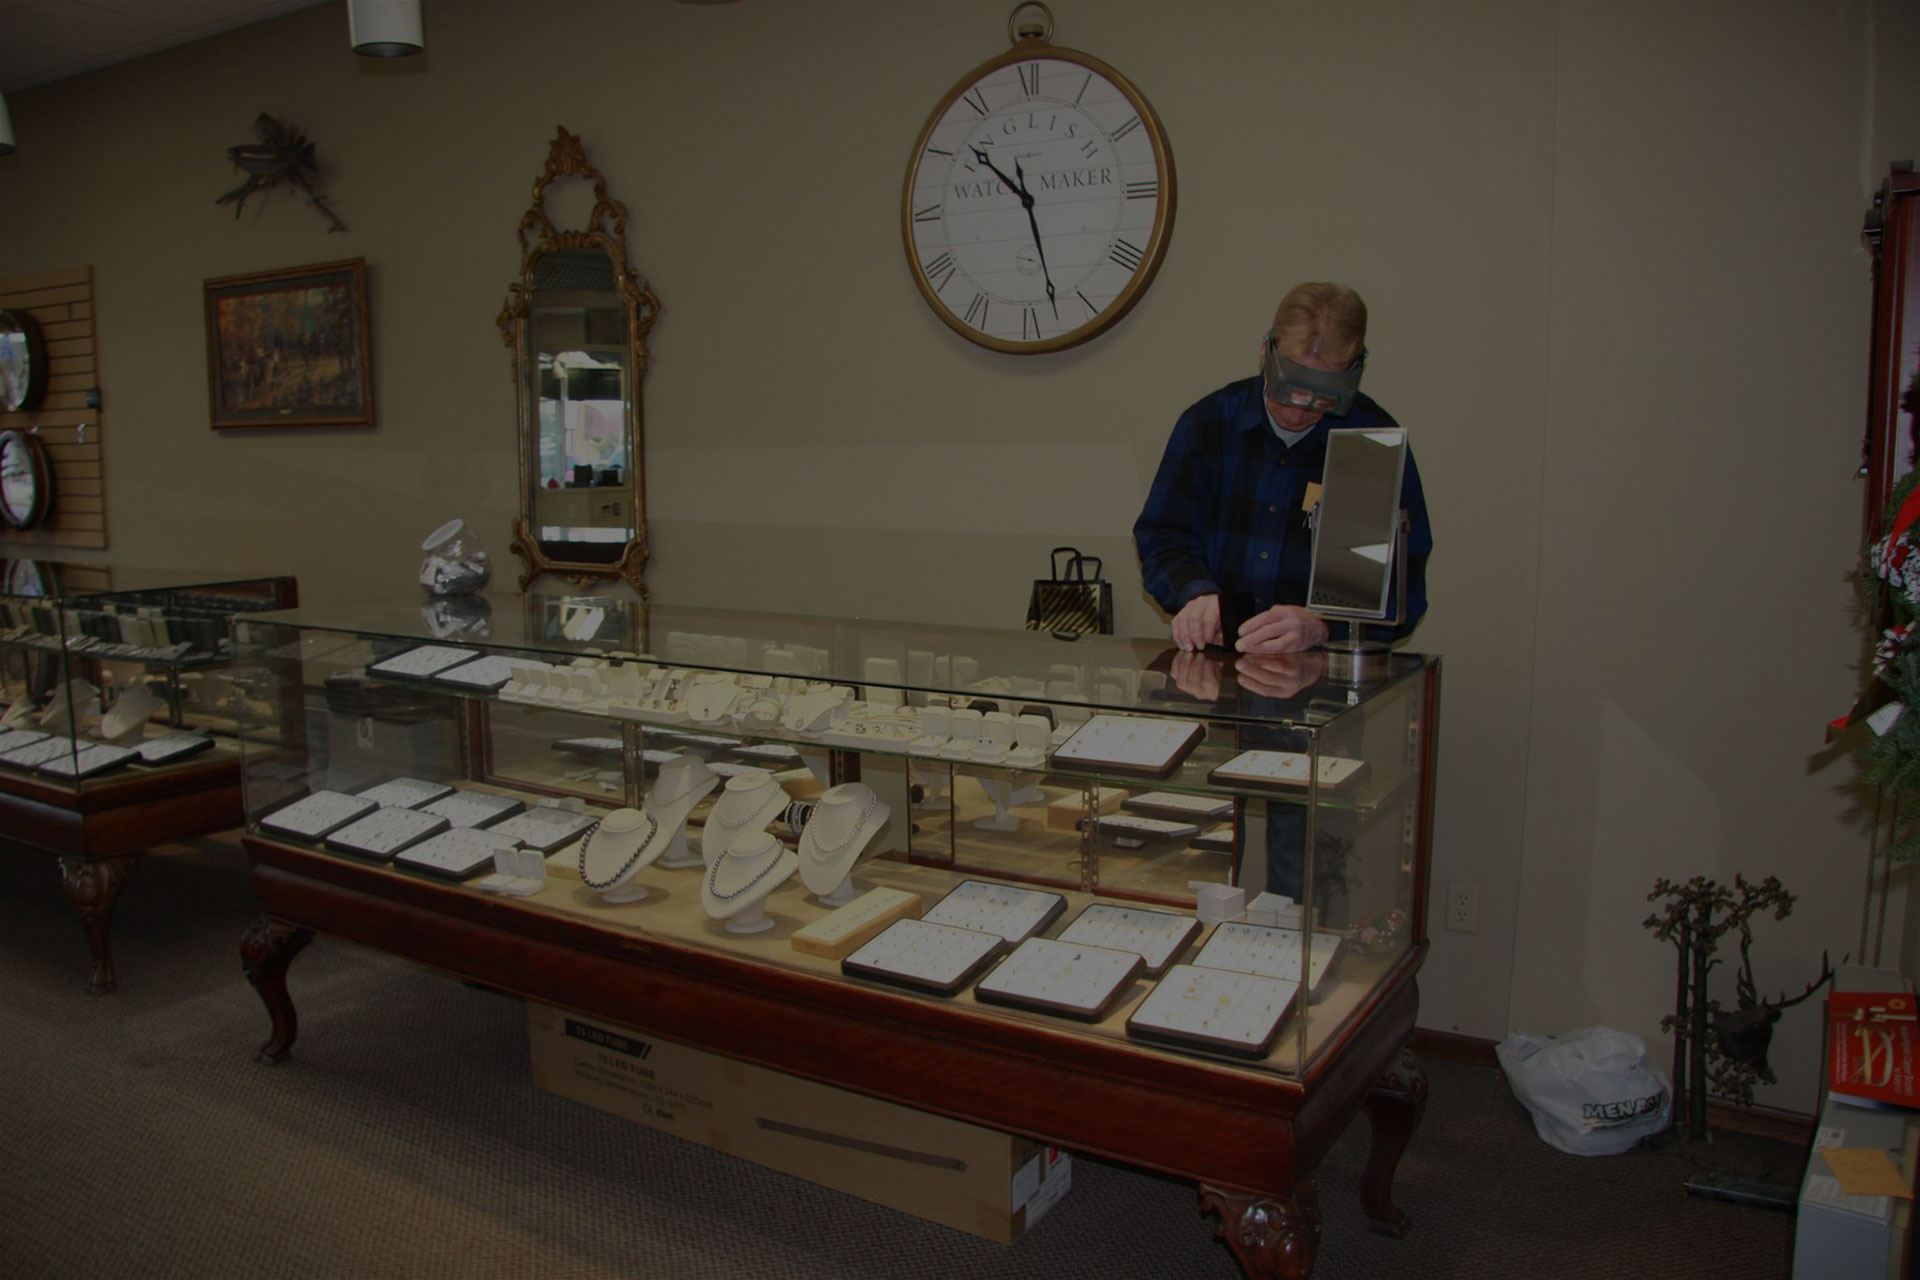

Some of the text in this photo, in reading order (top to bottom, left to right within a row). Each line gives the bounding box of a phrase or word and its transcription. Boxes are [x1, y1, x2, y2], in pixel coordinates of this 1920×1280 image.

[1017, 62, 1040, 97] XII
[964, 113, 1099, 174] ENGLISH
[954, 168, 1113, 200] WATC MAKER
[609, 1057, 628, 1070] LED
[630, 1063, 656, 1080] TUBE
